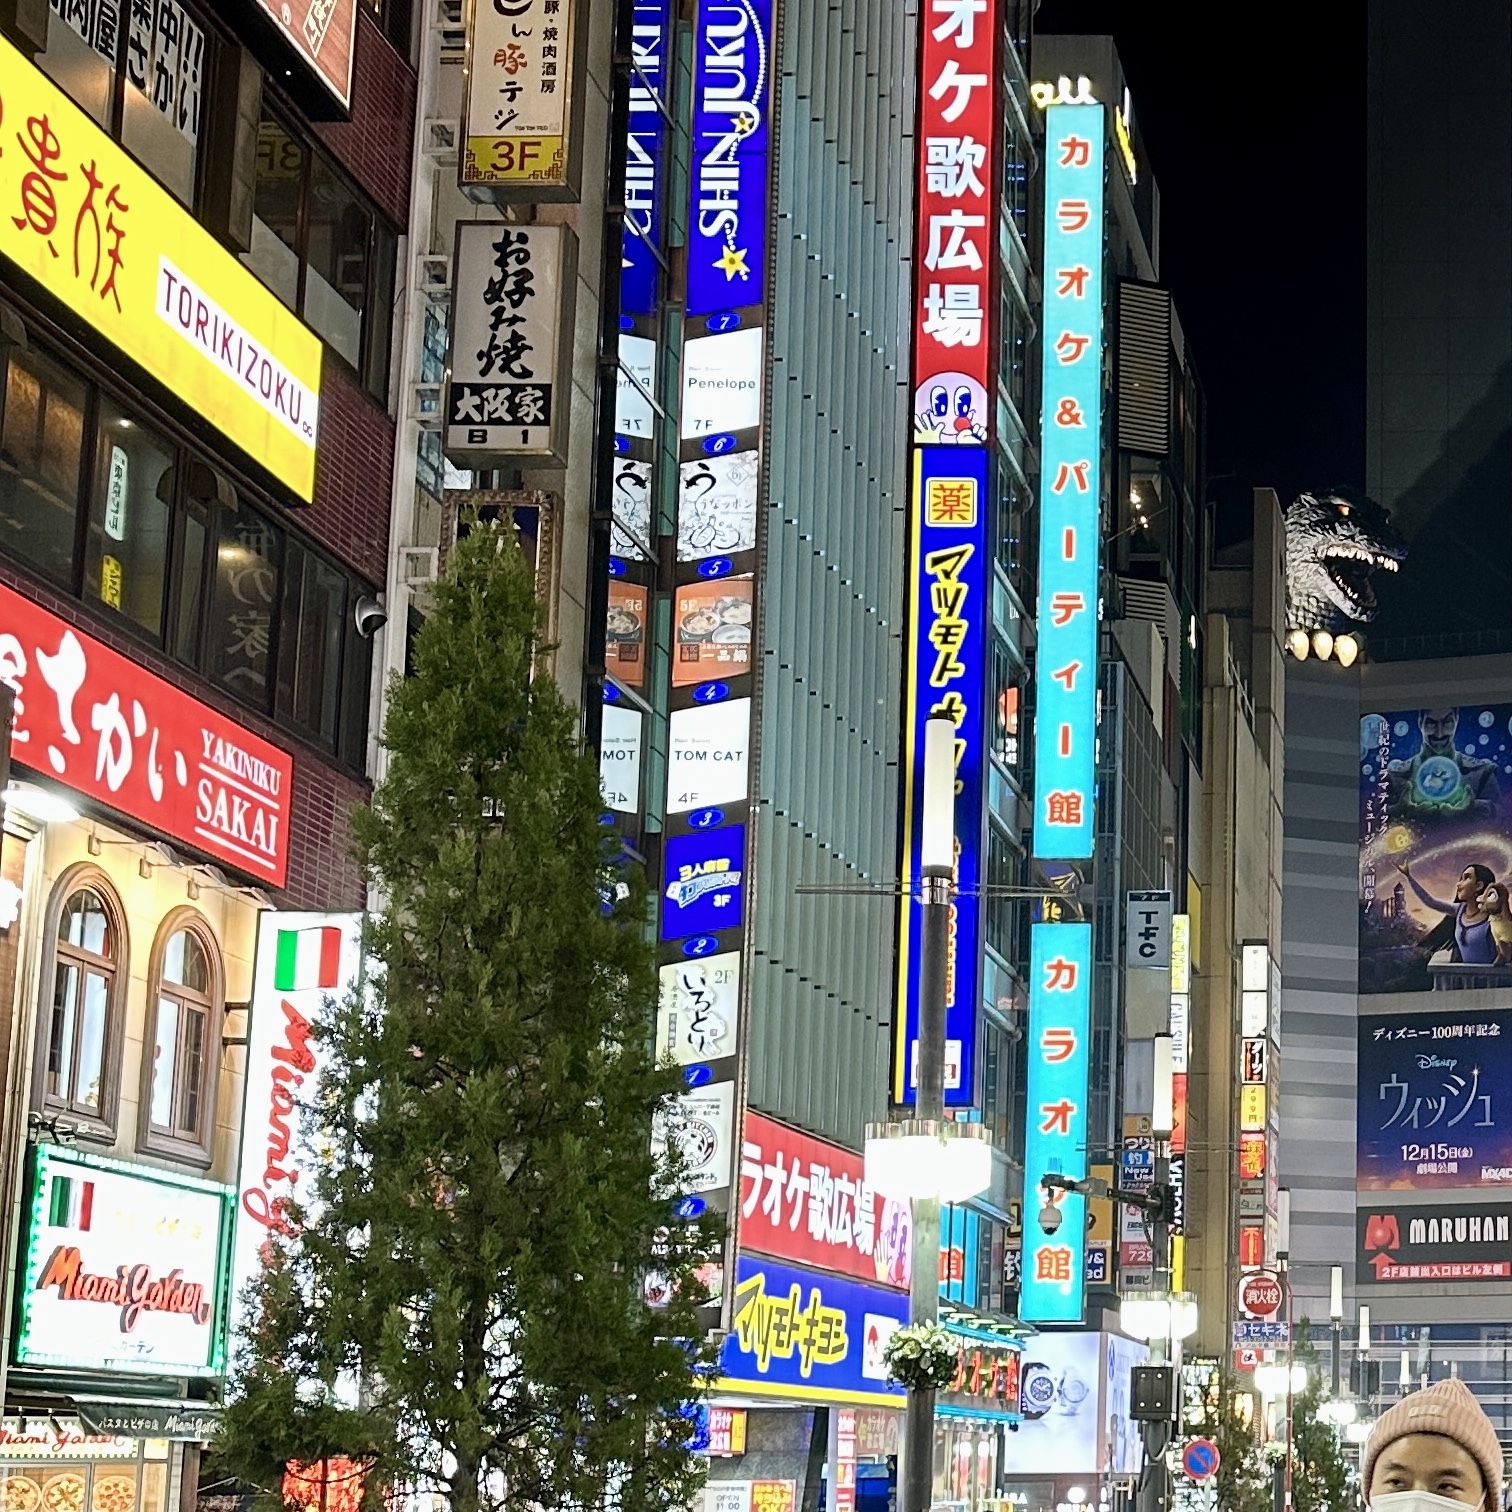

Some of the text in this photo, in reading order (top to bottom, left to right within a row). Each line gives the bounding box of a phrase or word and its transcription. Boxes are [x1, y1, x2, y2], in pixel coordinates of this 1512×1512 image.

[490, 140, 542, 172] 3F
[921, 0, 989, 349] オケ歌広場
[0, 95, 130, 314] 貴族
[476, 229, 536, 380] お好み焼
[162, 268, 303, 426] TORIKIZOKU
[454, 387, 546, 425] 大阪家
[688, 377, 756, 392] Penelope
[930, 483, 972, 523] 薬
[1046, 135, 1090, 826] カラオケ&パーティー館
[708, 560, 722, 576] 5
[200, 728, 282, 796] YAKINIKU
[674, 750, 743, 762] TOM CAT
[196, 778, 278, 857] SAKAI
[1379, 1066, 1496, 1131] ウィッシュ
[1409, 1215, 1510, 1244] MARUHAN
[36, 1245, 212, 1333] Miami Garden
[1245, 1288, 1279, 1305] 消火栓
[735, 1275, 848, 1375] マツモトキヨシ
